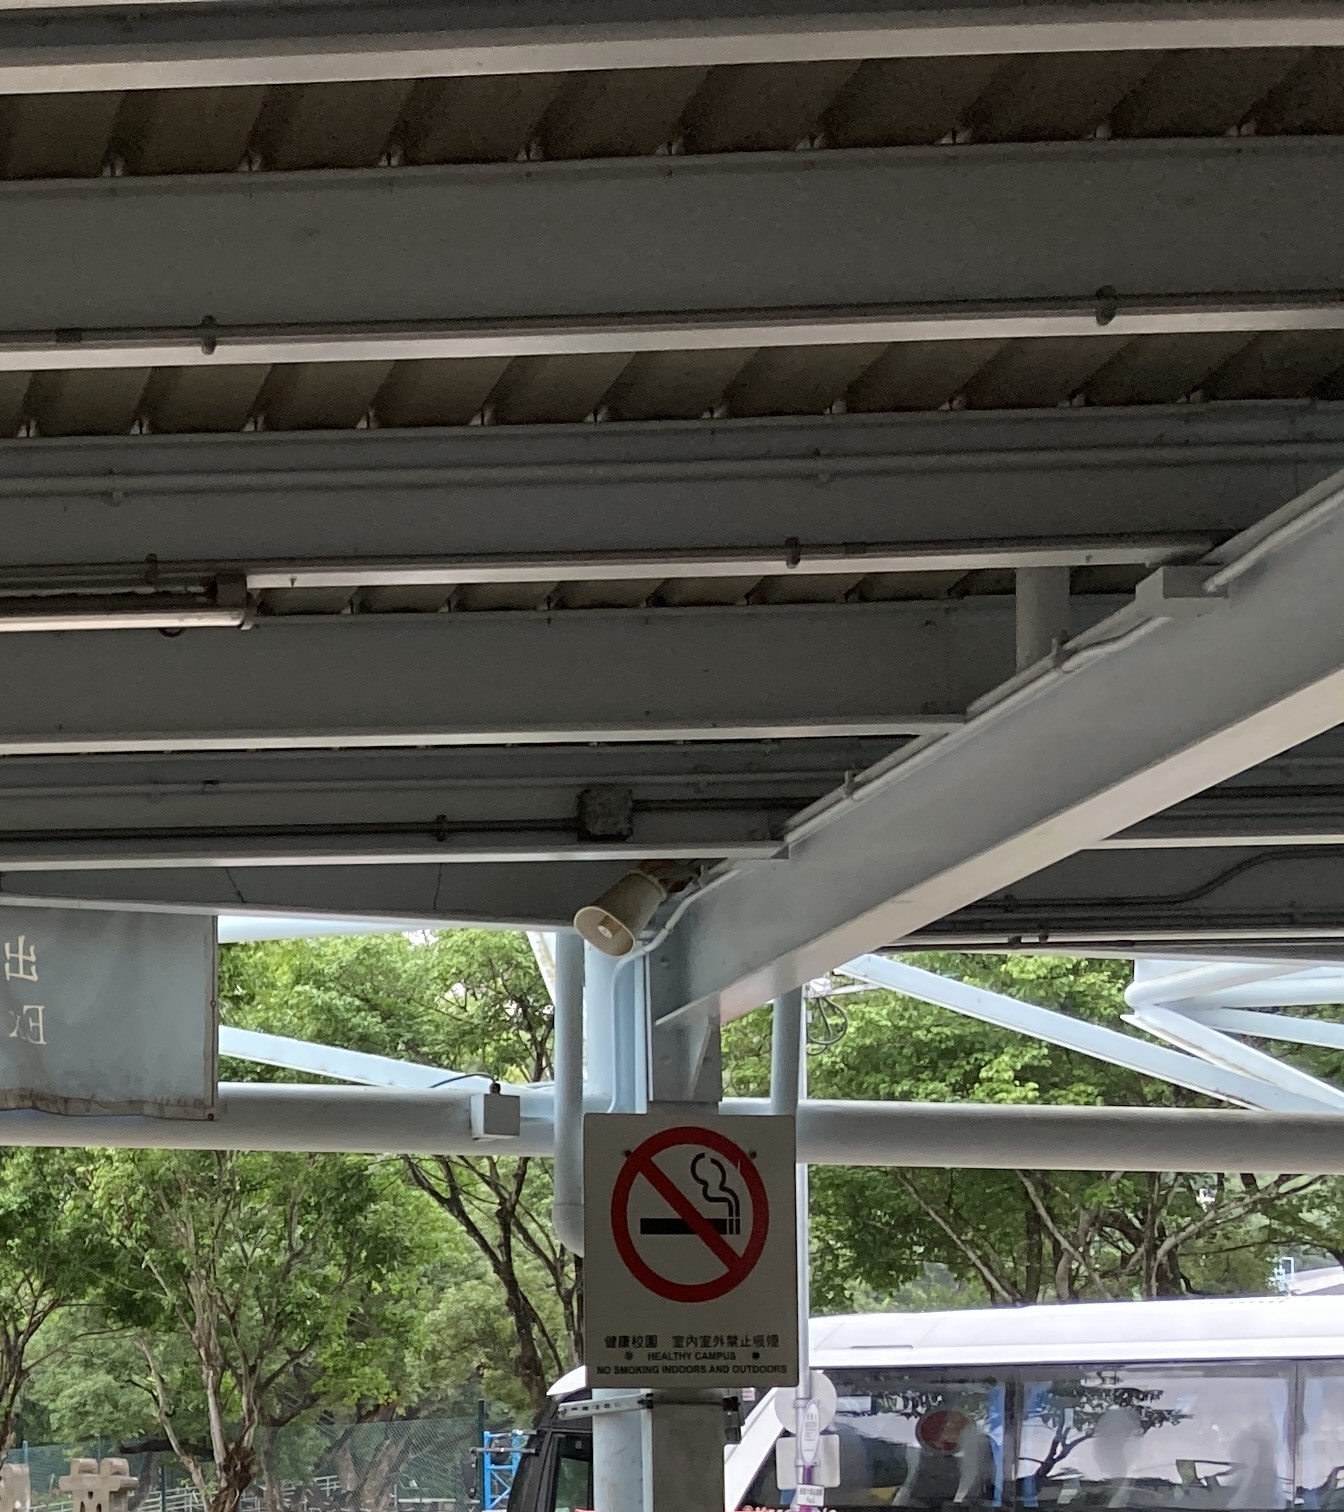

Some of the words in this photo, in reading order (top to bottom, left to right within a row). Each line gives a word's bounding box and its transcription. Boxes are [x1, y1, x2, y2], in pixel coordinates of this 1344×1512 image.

[604, 1334, 658, 1349] 健康校園
[648, 1352, 692, 1361] HEALTHY
[694, 1352, 736, 1361] CAMPUS
[597, 1366, 611, 1374] NO
[613, 1365, 659, 1374] SMOKING
[662, 1365, 707, 1374] INDOORS
[709, 1365, 730, 1373] AND
[732, 1364, 787, 1373] OUTDOORS
